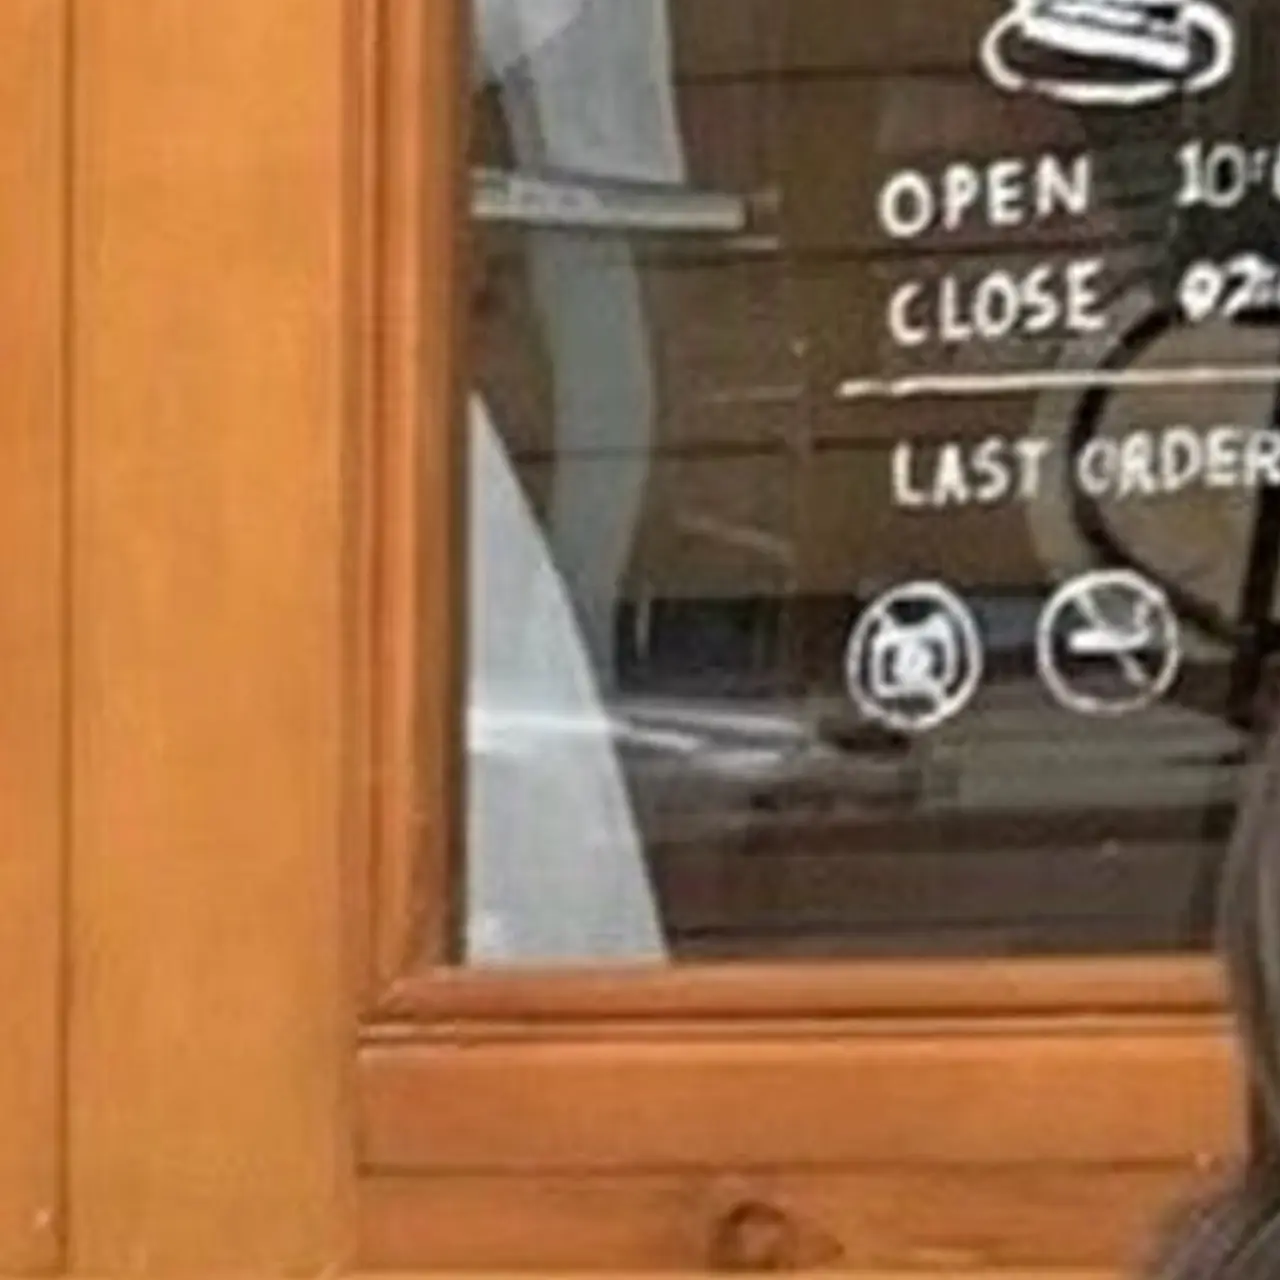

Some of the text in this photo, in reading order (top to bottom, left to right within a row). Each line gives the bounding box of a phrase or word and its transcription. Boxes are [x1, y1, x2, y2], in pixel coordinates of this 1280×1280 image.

[878, 151, 1091, 239] OPEN
[887, 256, 1108, 347] CLOSE
[889, 436, 1050, 508] LAST
